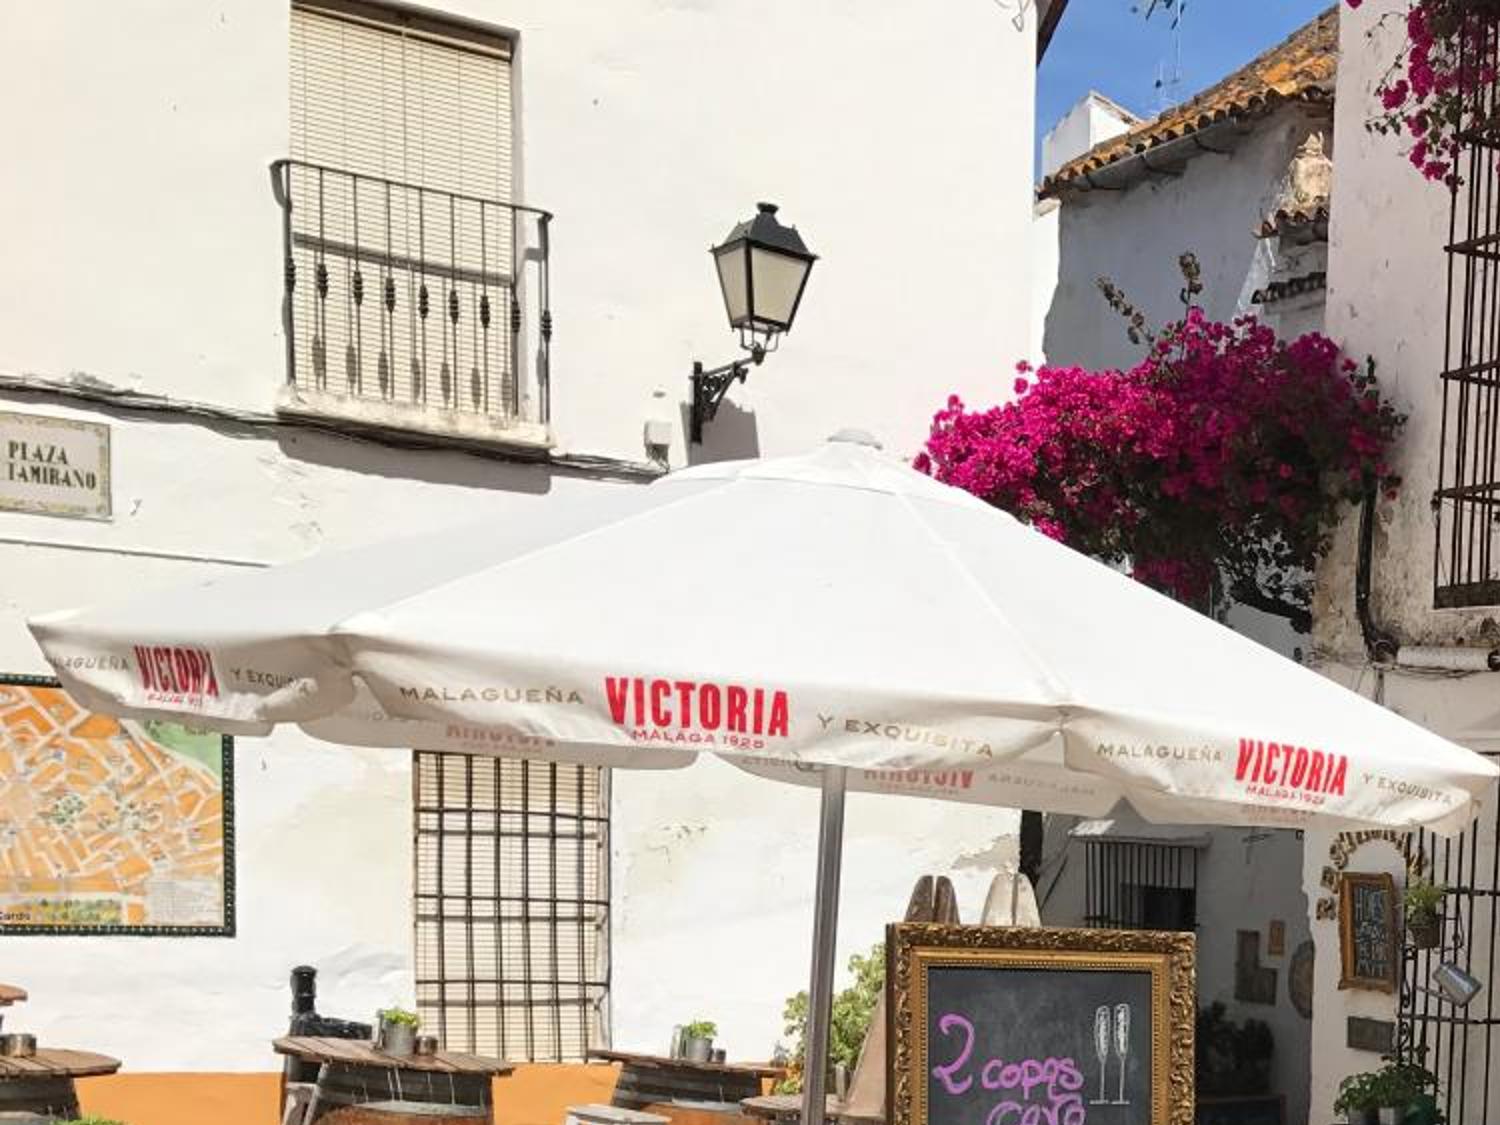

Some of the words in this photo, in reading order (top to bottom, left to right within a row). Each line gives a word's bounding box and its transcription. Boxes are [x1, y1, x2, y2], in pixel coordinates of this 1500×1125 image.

[8, 440, 68, 465] PLAZA
[134, 645, 219, 697] VICTORIA
[400, 686, 584, 705] MALAGUEÑA
[605, 676, 790, 738] VICTORIA
[817, 712, 834, 730] Y
[844, 718, 993, 758] EXQUISITA
[1235, 737, 1347, 797] VICTORIA
[932, 1013, 975, 1095] 2
